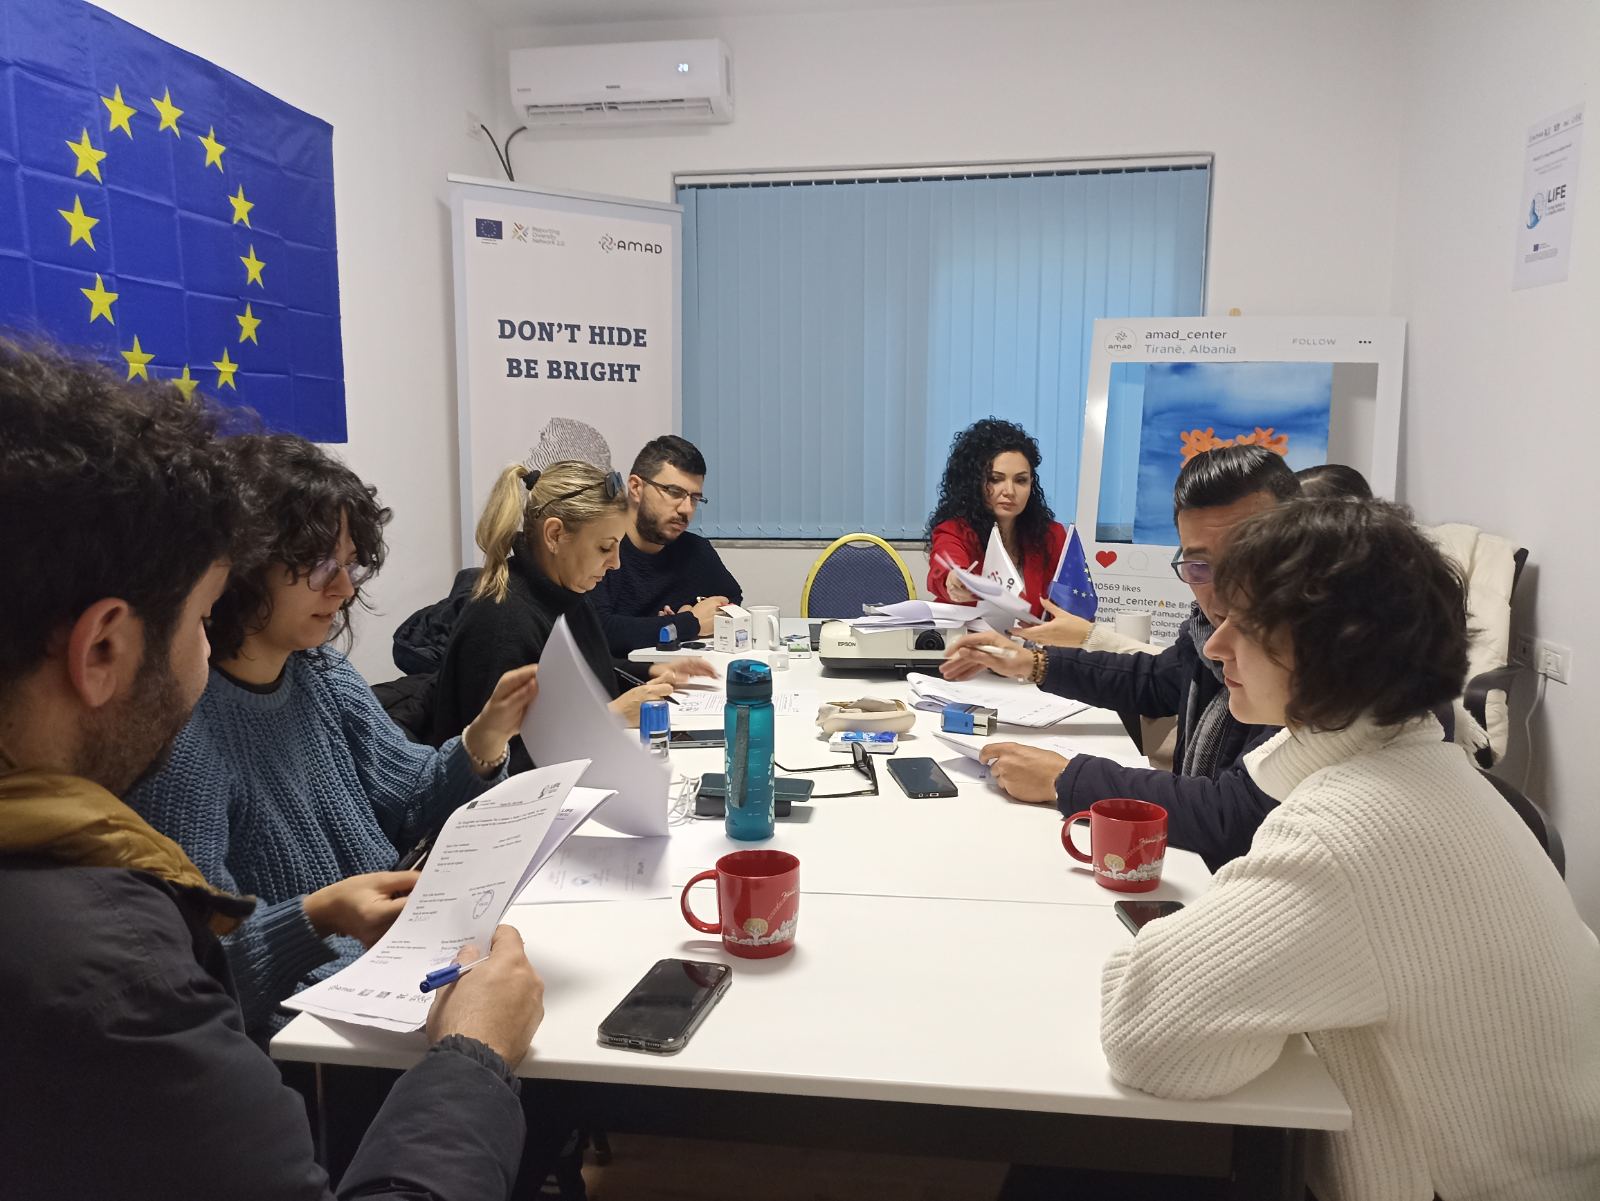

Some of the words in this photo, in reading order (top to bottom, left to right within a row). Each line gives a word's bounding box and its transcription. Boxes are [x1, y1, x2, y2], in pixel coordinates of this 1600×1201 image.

[1547, 184, 1567, 203] LIFE
[617, 240, 663, 254] AMAD
[498, 319, 581, 343] DON'T
[588, 325, 647, 347] HIDE
[1145, 330, 1227, 341] amad_center
[1190, 344, 1237, 355] Albania
[506, 358, 539, 379] BE
[547, 359, 641, 383] BRIGHT
[1122, 584, 1141, 592] likes
[1098, 596, 1158, 607] mad_center
[1165, 601, 1177, 609] Be
[1151, 610, 1190, 619] #amadce
